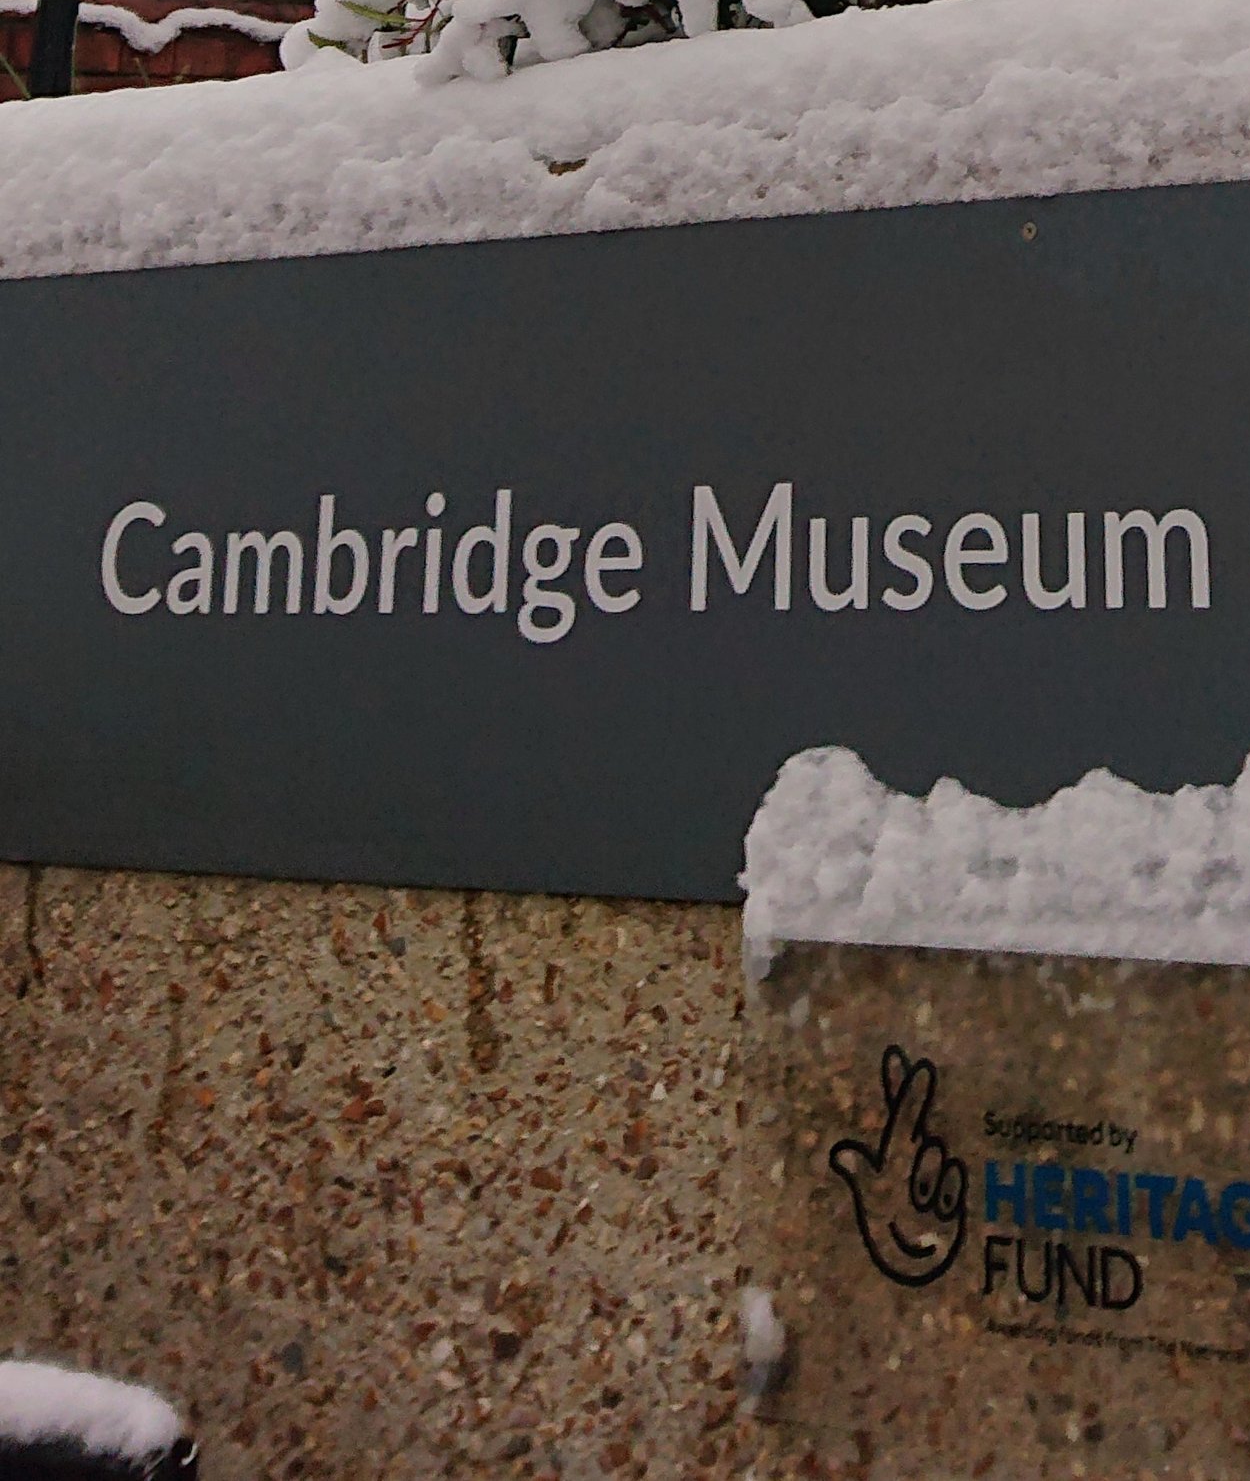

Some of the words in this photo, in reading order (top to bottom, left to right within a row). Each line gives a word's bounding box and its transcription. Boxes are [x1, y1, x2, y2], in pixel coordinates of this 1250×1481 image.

[101, 487, 643, 644] Cambridge
[690, 482, 1210, 612] Museum
[984, 1110, 1104, 1146] Supported
[1108, 1122, 1138, 1154] by
[983, 1235, 1143, 1310] FUND
